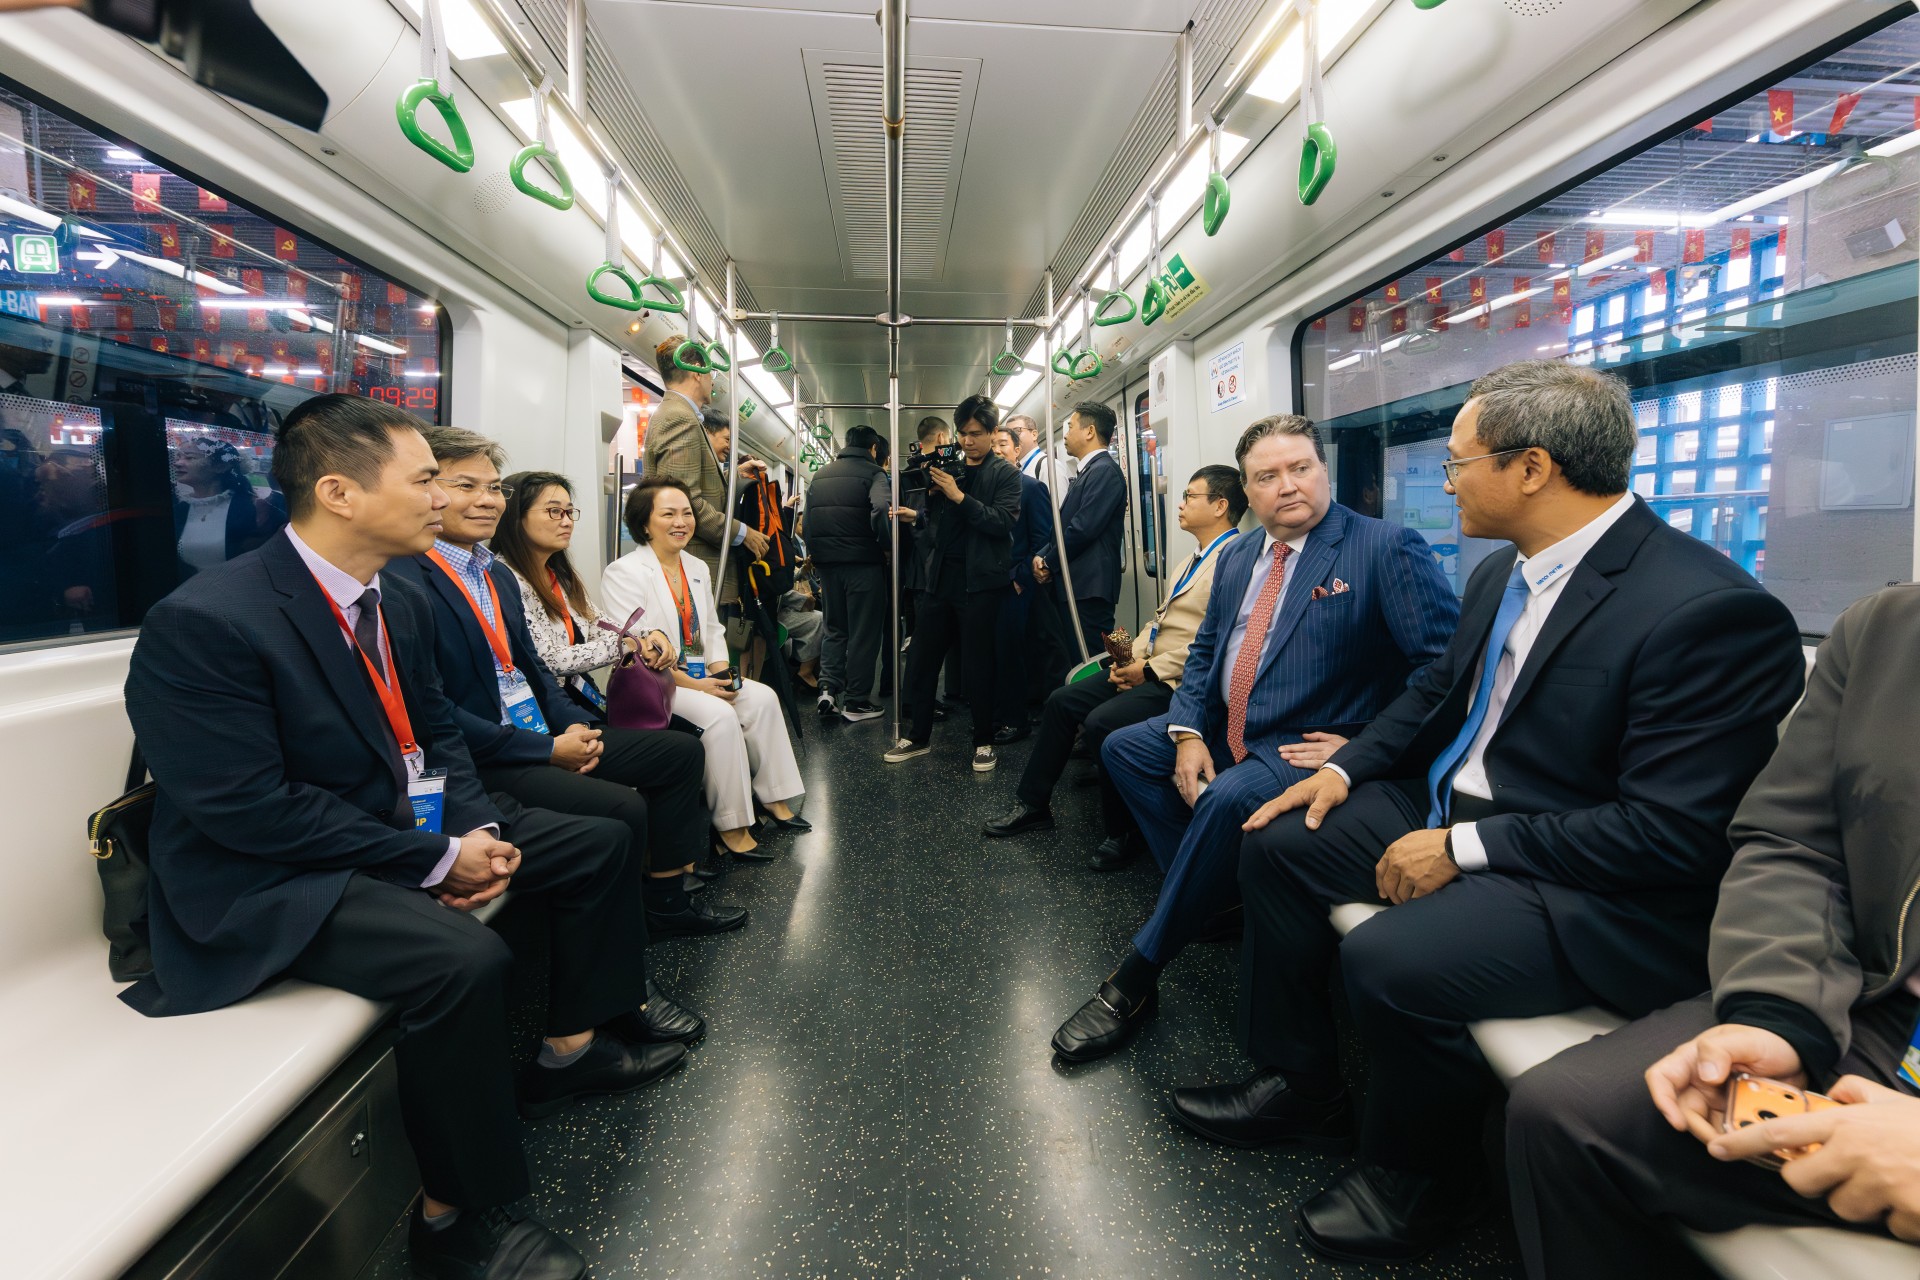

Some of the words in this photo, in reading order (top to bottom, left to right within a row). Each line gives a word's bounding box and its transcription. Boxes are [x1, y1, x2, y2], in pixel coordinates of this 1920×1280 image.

[369, 386, 437, 408] 09:29
[937, 447, 952, 457] VTV
[415, 817, 427, 826] IP
